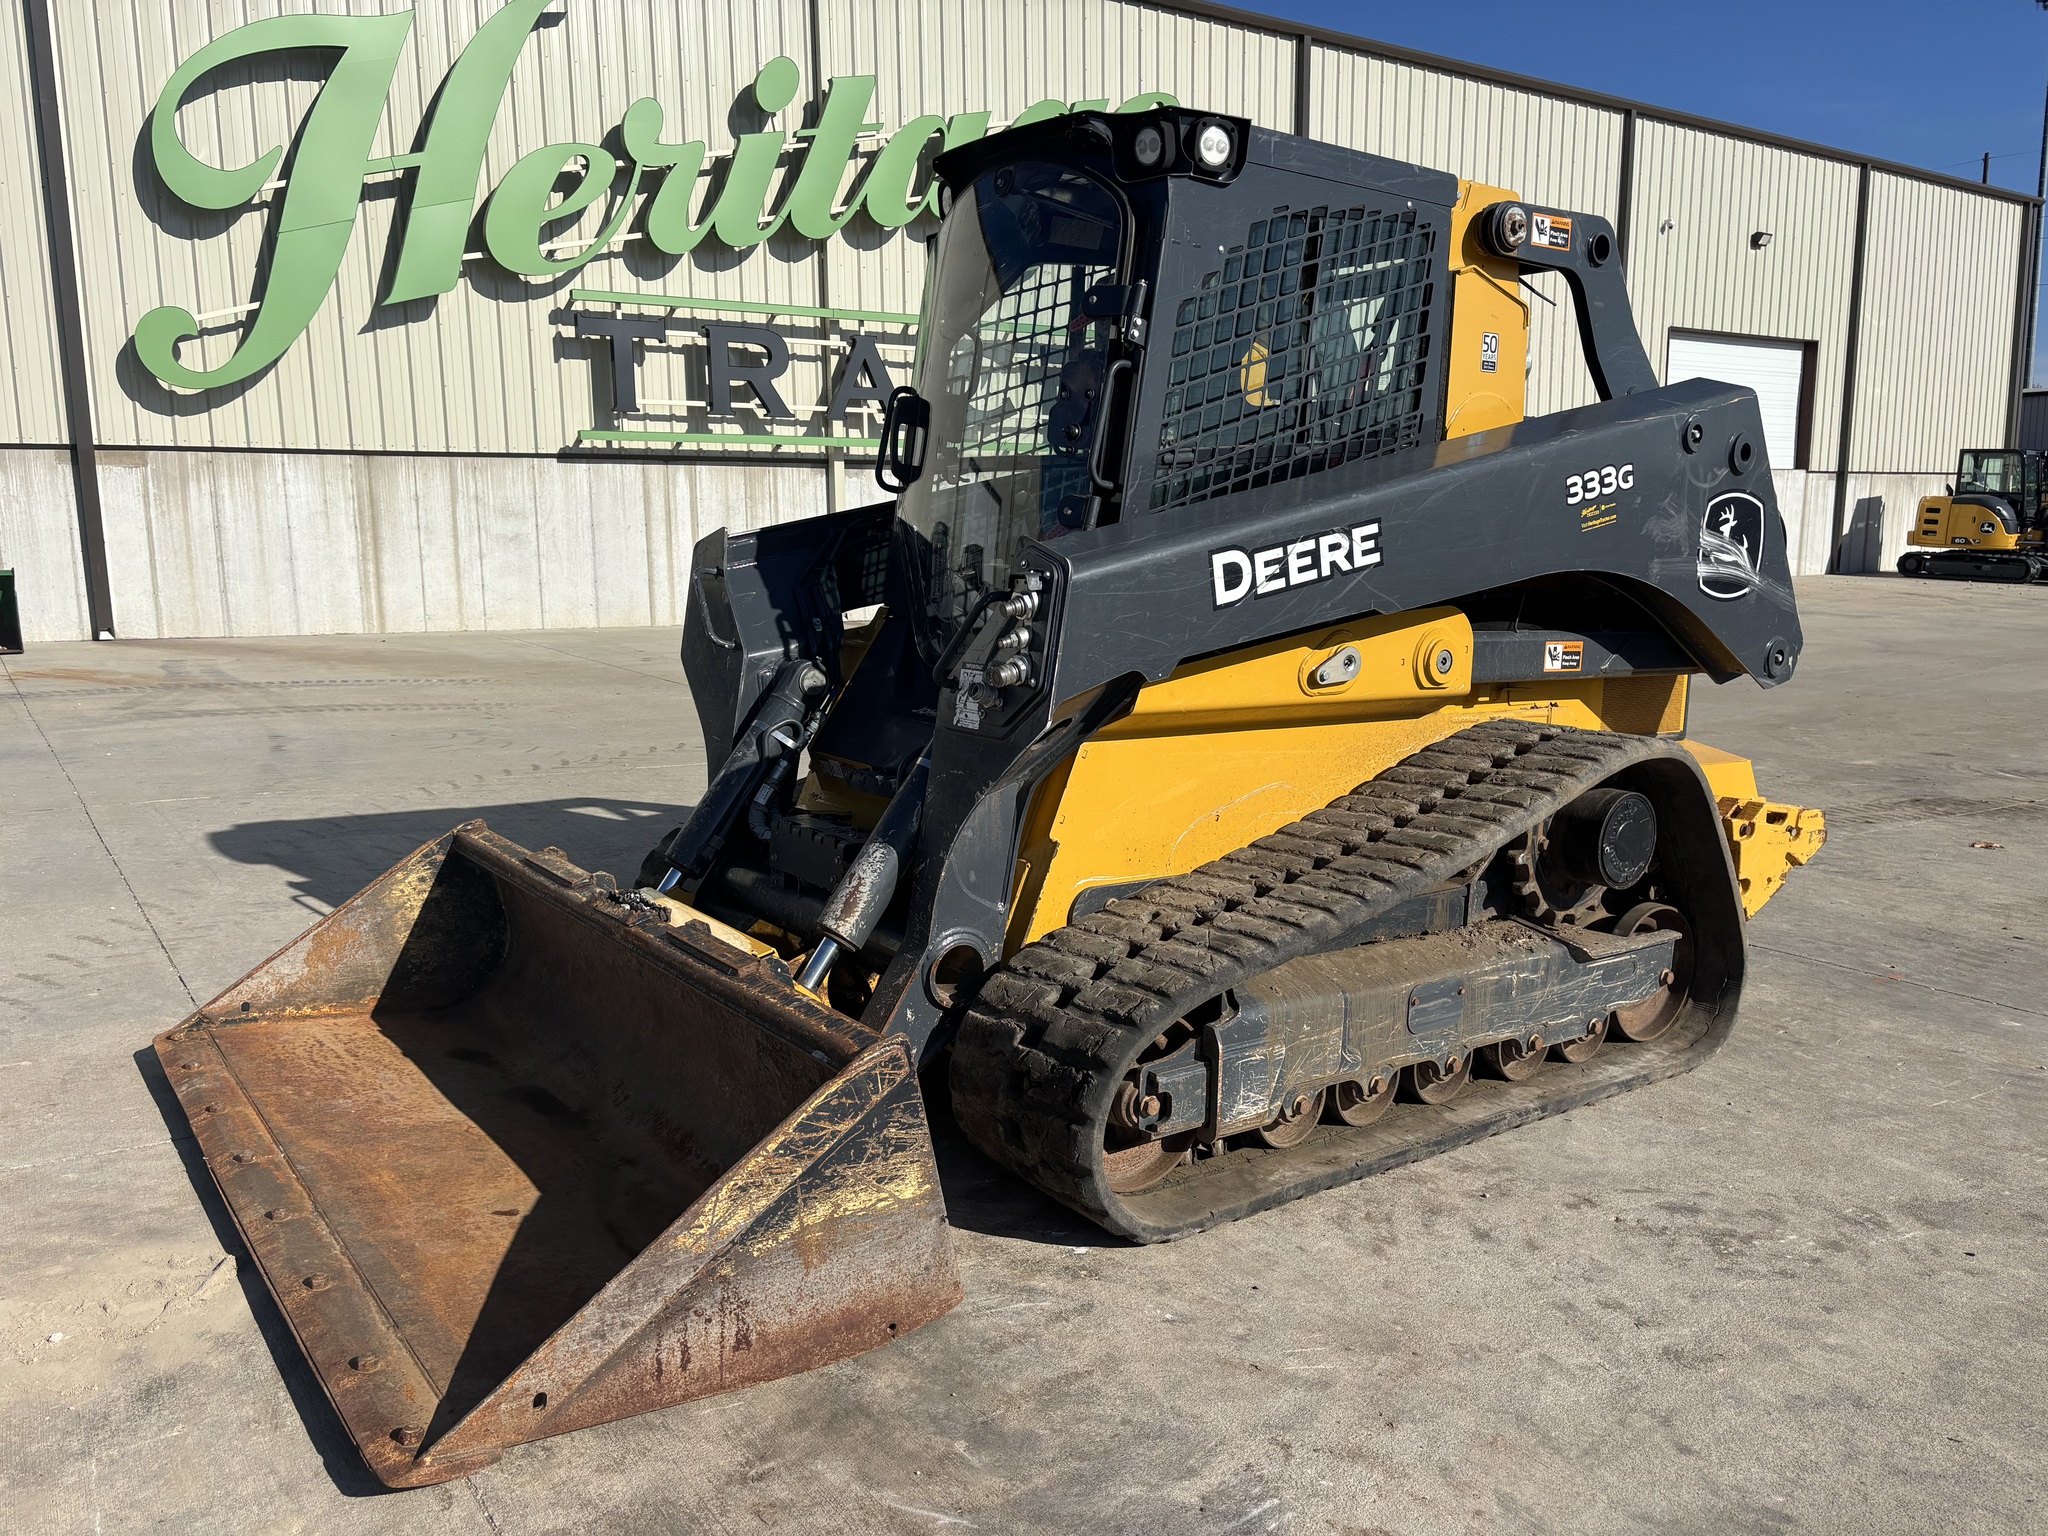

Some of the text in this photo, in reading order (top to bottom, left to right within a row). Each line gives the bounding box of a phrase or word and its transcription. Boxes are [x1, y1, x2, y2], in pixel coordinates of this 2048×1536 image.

[133, 0, 1180, 390] Herita
[574, 312, 902, 421] TRA
[1482, 334, 1498, 354] 50
[1482, 352, 1497, 361] YEARS
[1565, 463, 1635, 506] 333G
[1211, 522, 1382, 606] DEERE
